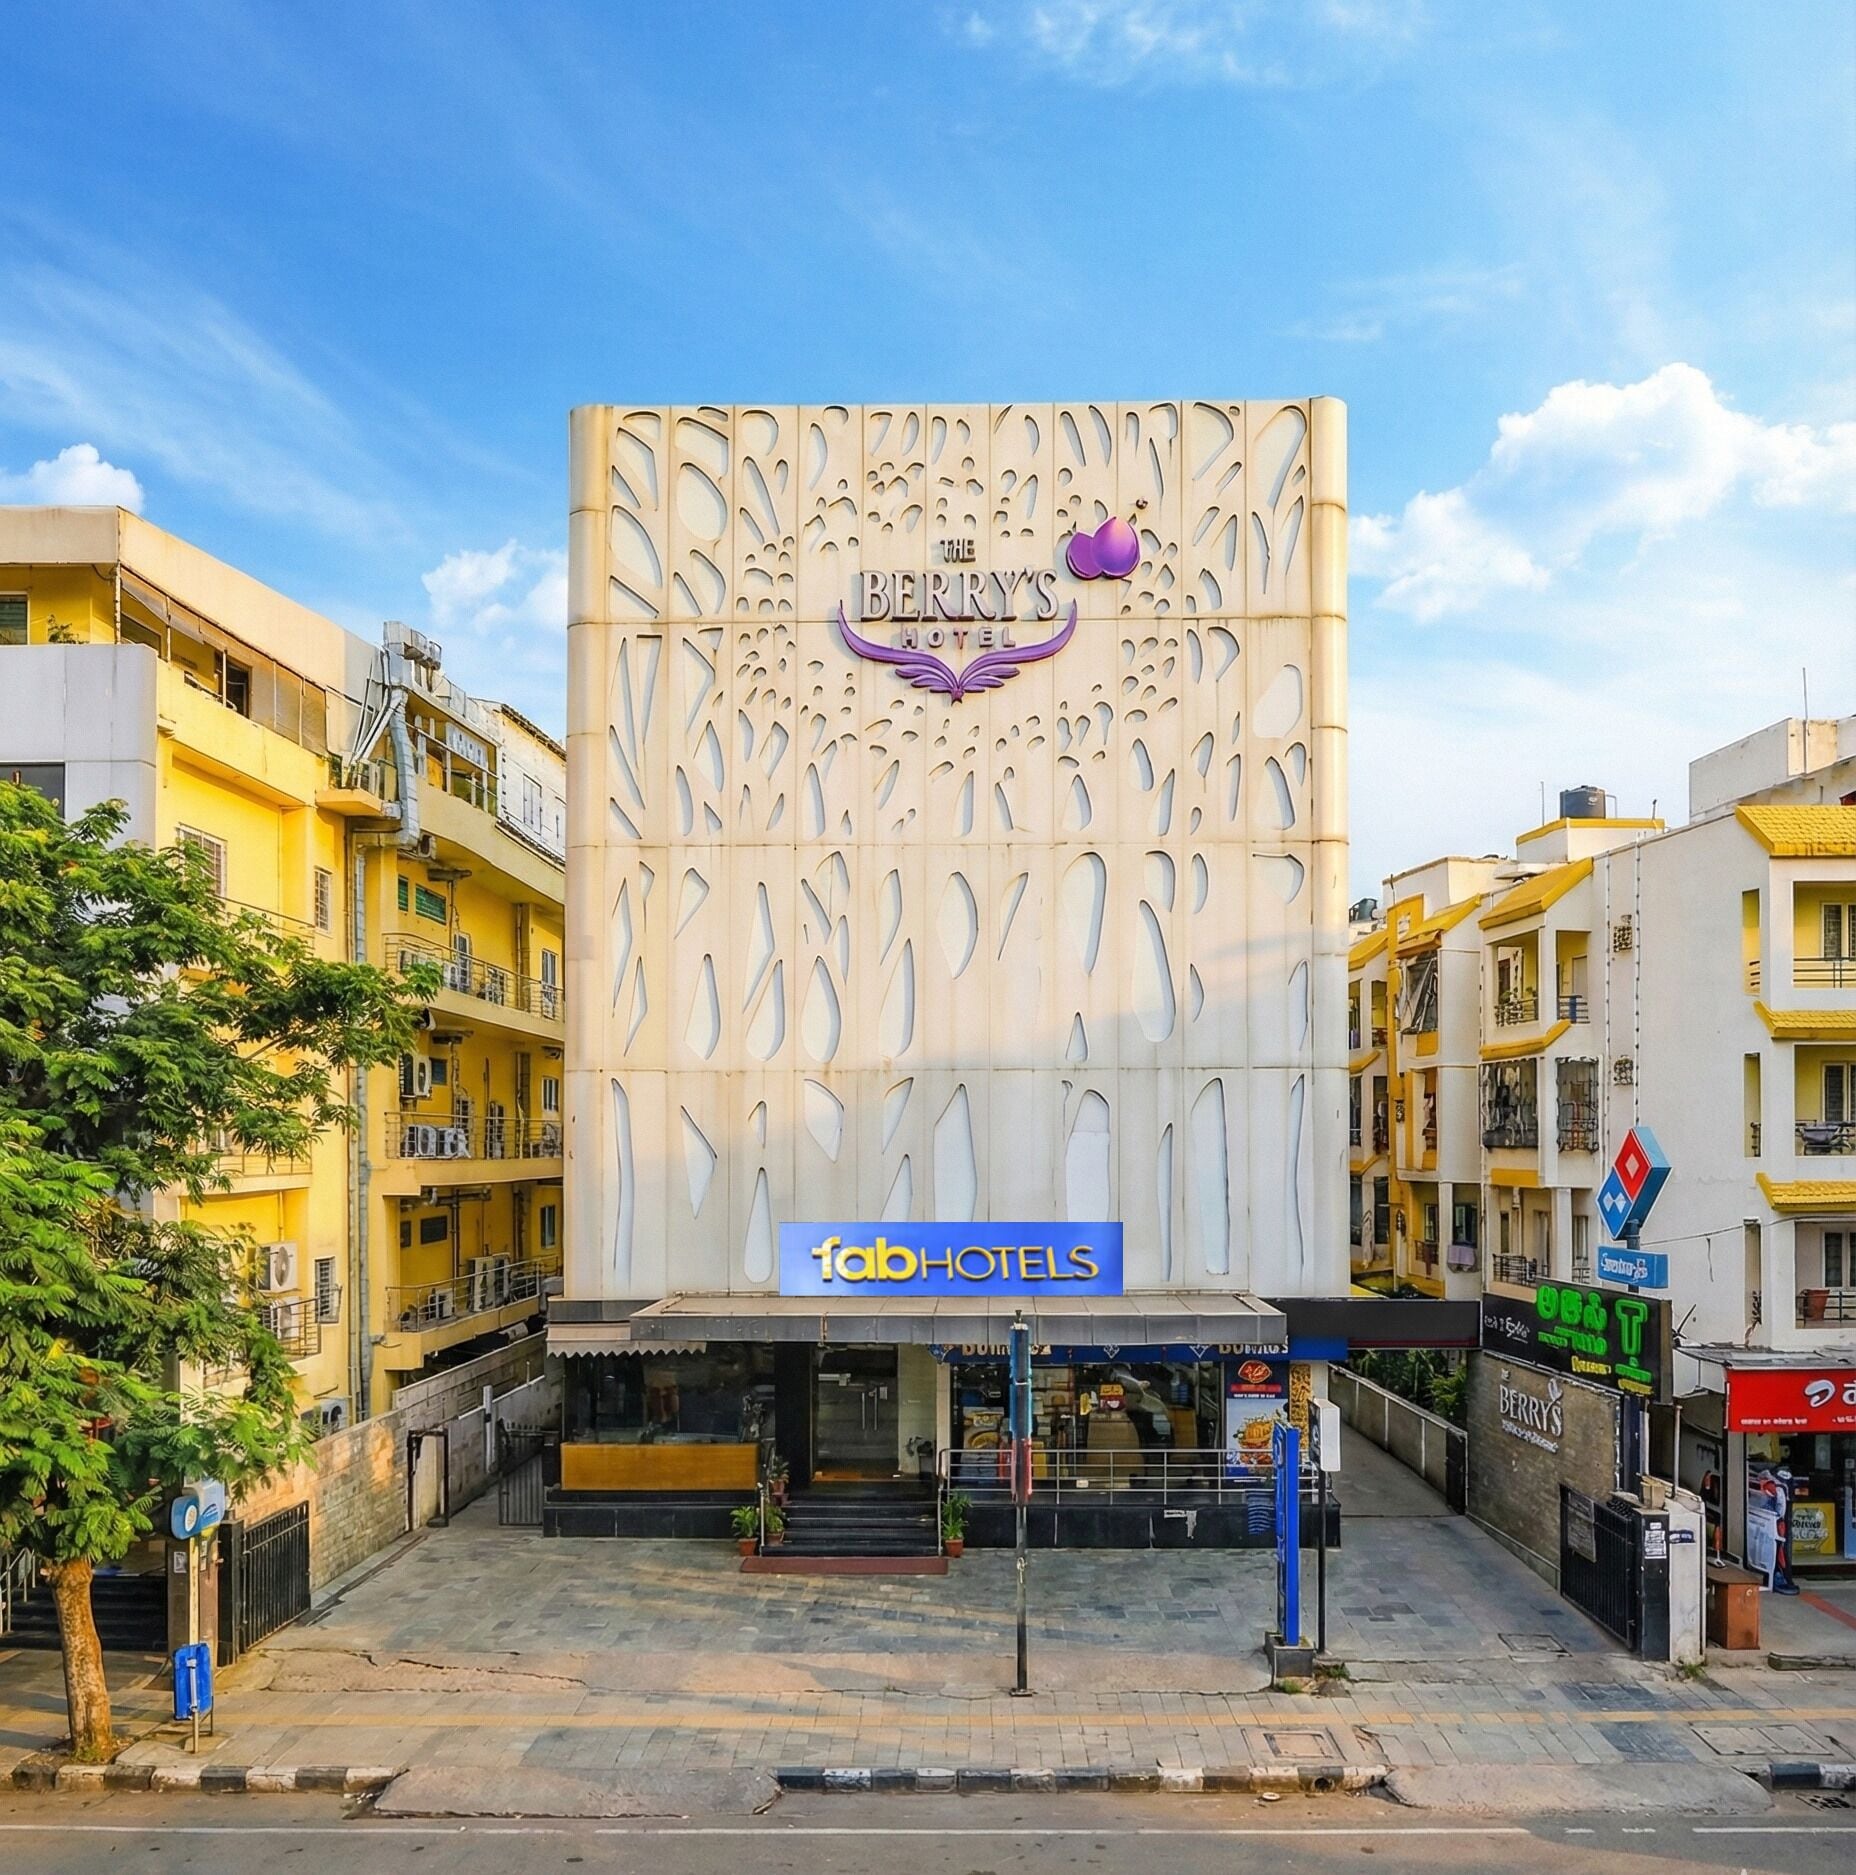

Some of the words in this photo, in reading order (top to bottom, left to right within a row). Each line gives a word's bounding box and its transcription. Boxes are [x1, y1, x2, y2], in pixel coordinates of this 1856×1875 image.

[940, 538, 976, 562] THE
[860, 567, 1059, 622] BERRY'S
[902, 626, 1016, 650] HOTEL
